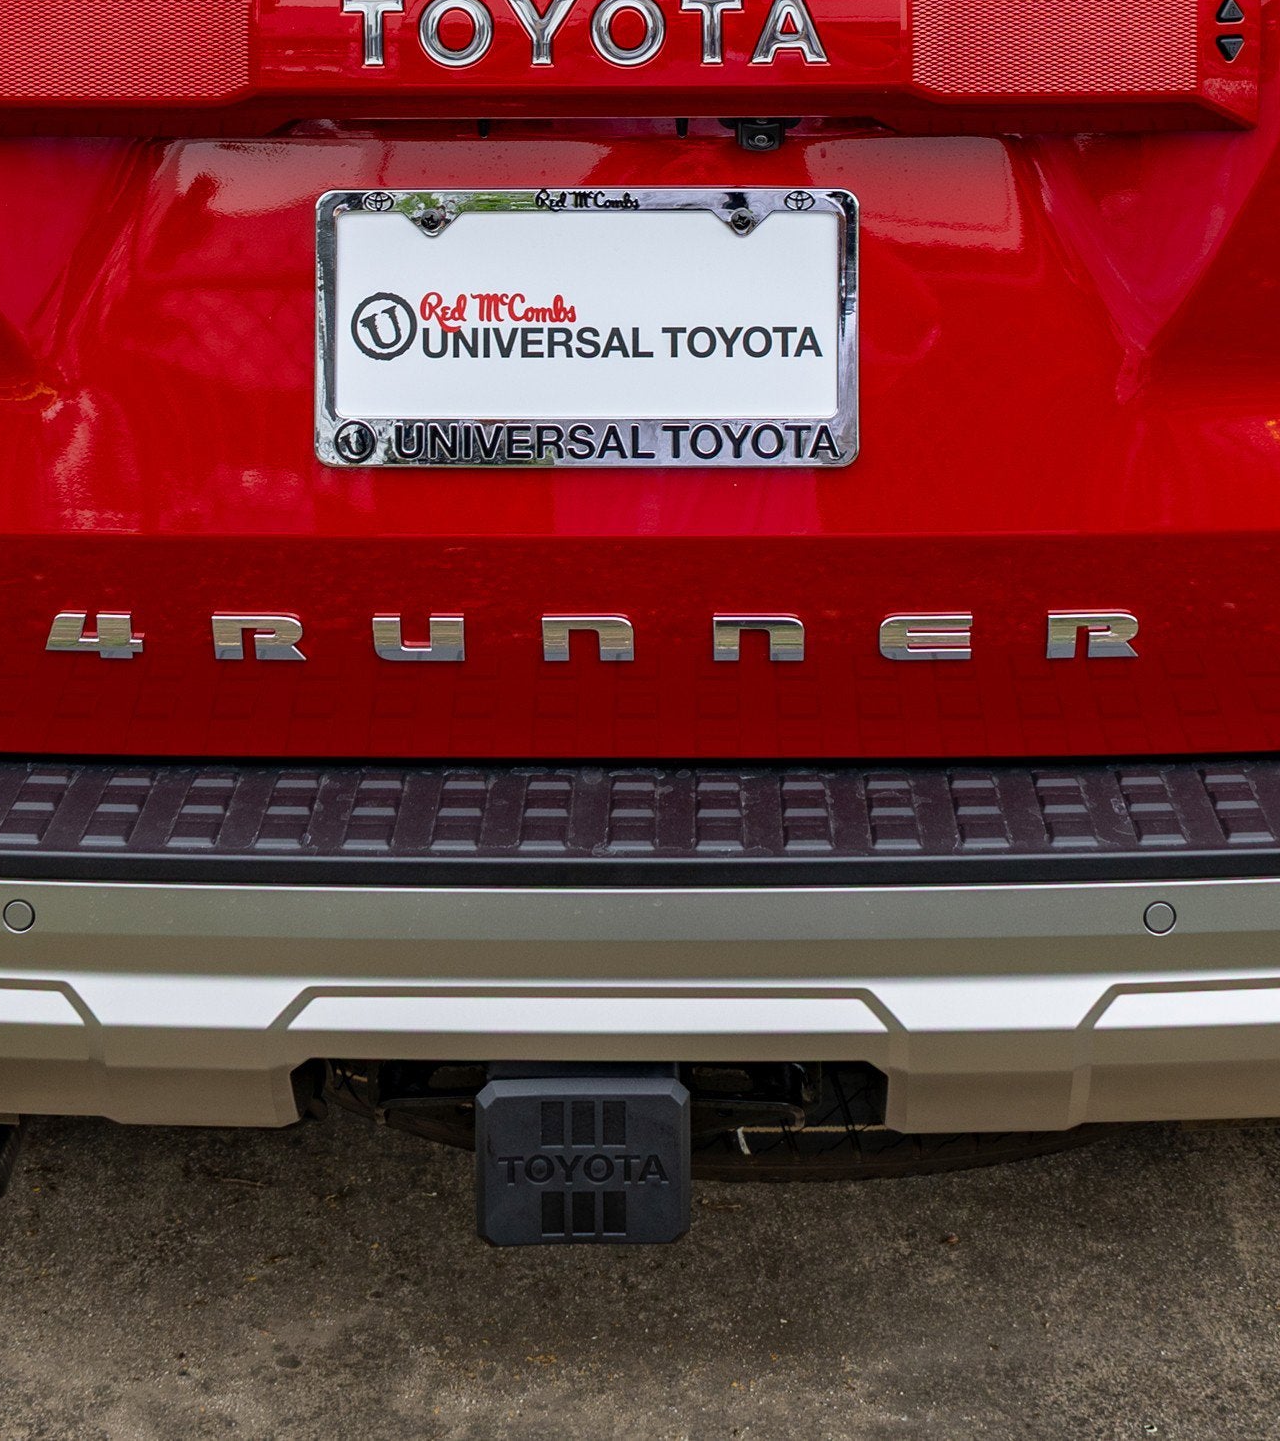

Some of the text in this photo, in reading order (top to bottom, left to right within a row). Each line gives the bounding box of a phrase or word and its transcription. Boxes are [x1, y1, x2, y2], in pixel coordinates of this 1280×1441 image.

[535, 189, 640, 212] Red McCombs
[420, 292, 577, 333] Red McCombs
[422, 326, 823, 359] UNIVERSAL TOYOTA
[394, 423, 656, 460] UNIVERSAL
[661, 423, 841, 460] TOYOTA
[45, 612, 1139, 661] 4RUNNER
[497, 1153, 670, 1185] TOYOTA
